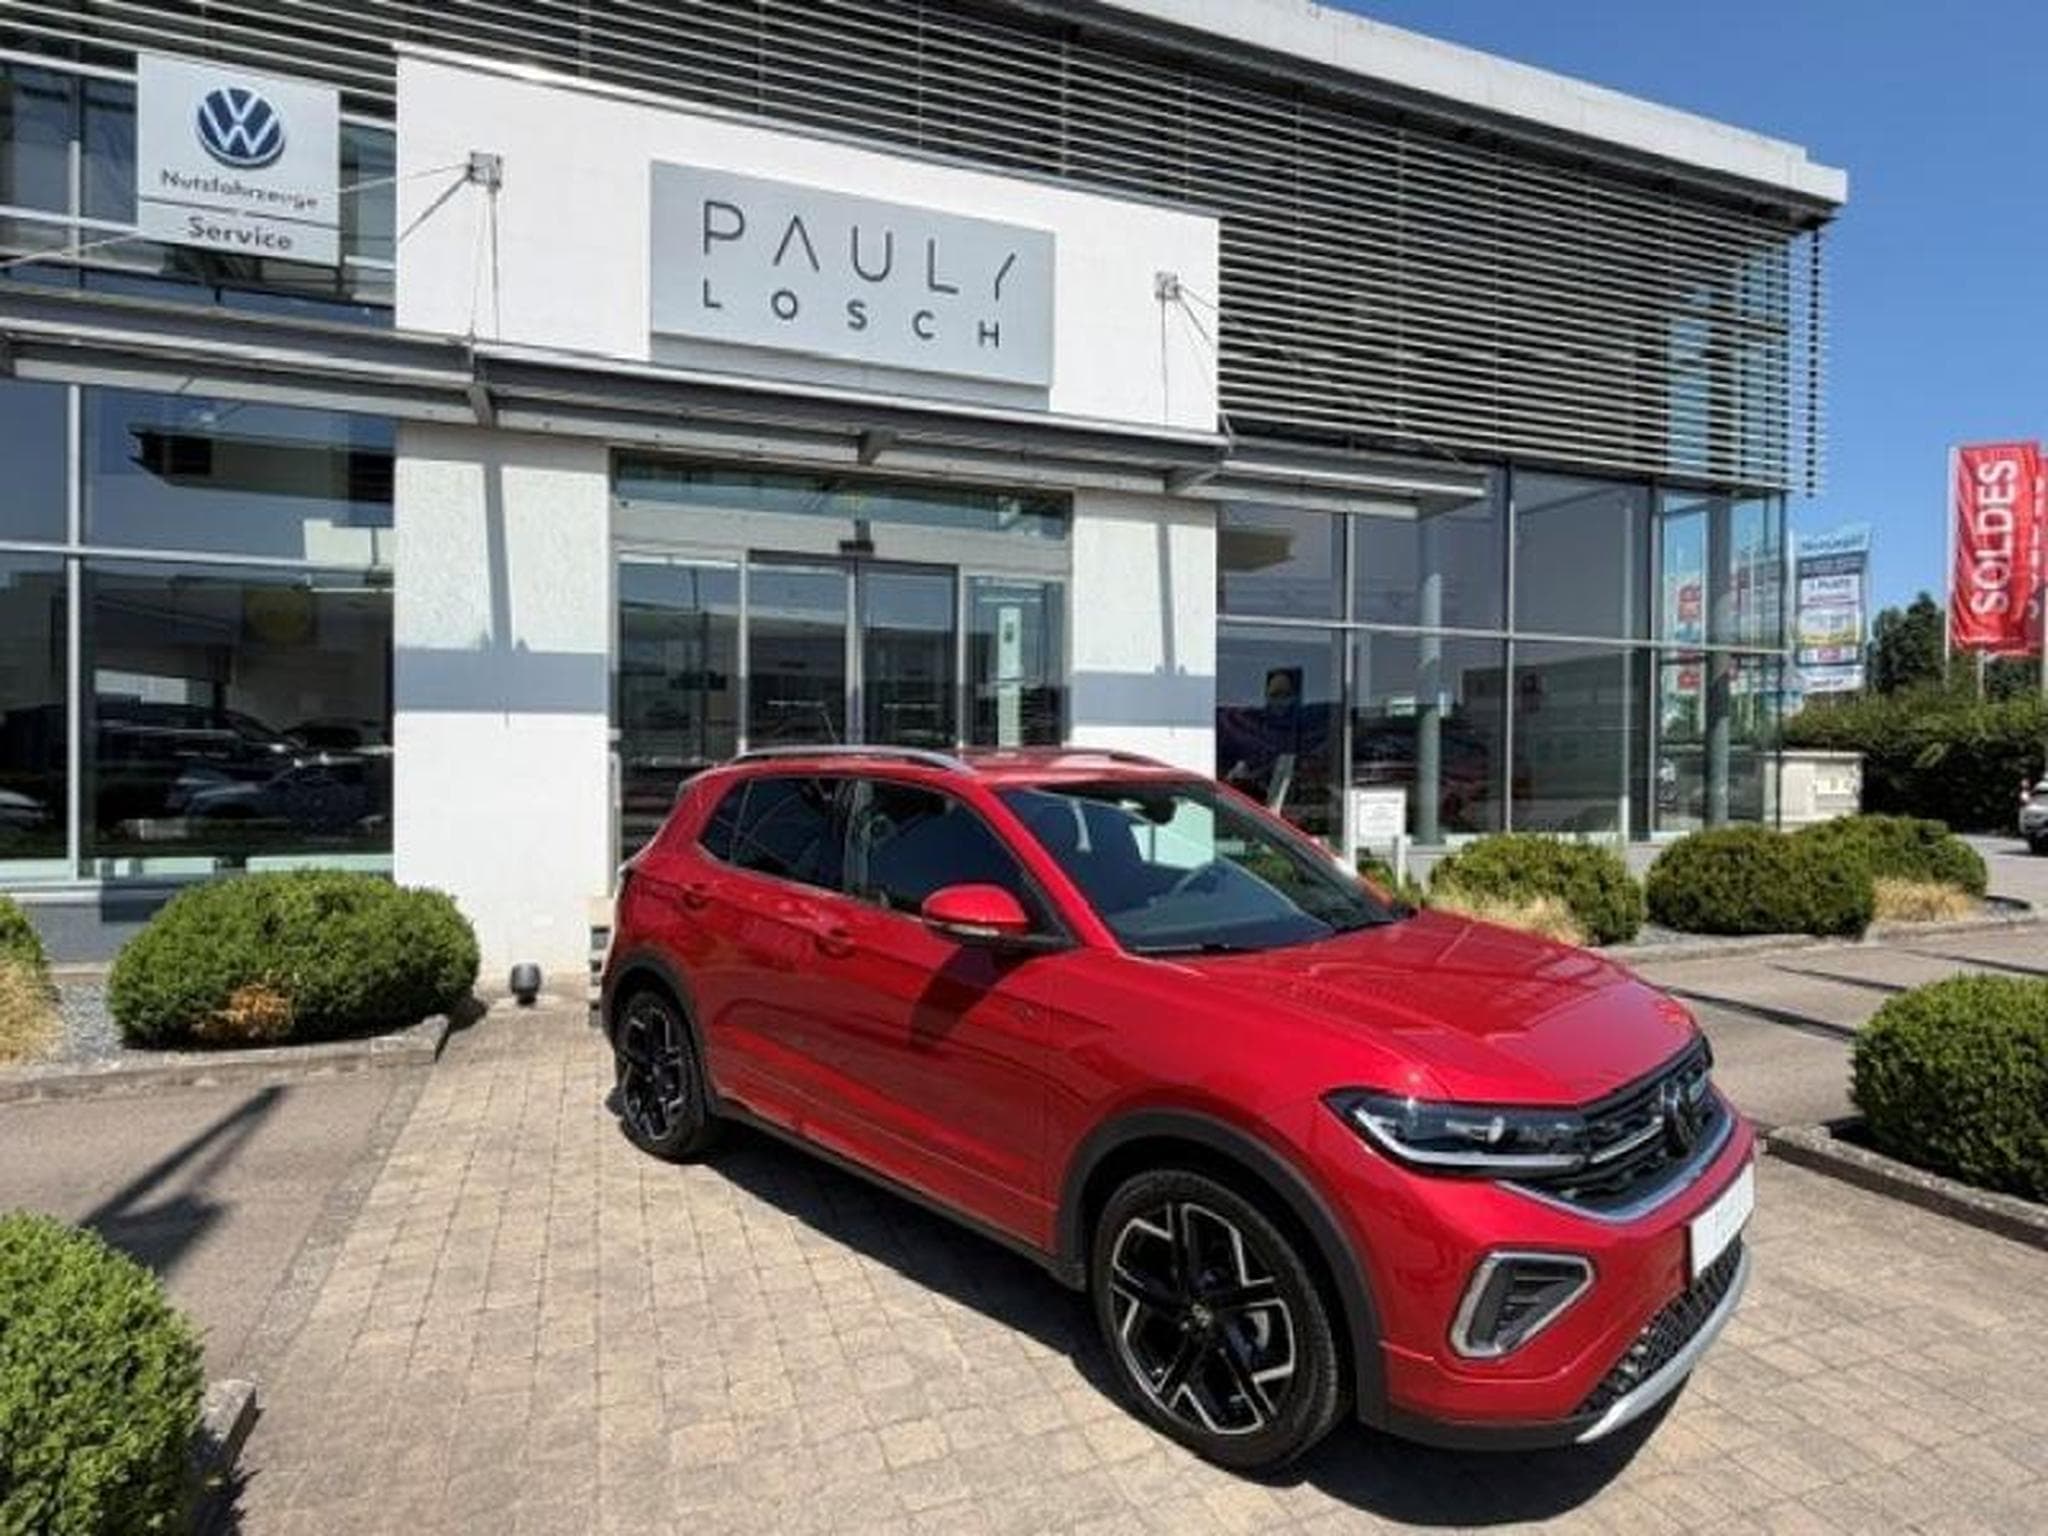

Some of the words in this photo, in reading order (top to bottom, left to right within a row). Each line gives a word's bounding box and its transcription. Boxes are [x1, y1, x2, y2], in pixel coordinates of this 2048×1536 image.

[188, 216, 292, 249] Service
[703, 200, 1016, 301] PAULY
[703, 279, 1000, 347] LOSCH
[1970, 459, 2017, 615] SOLDES
